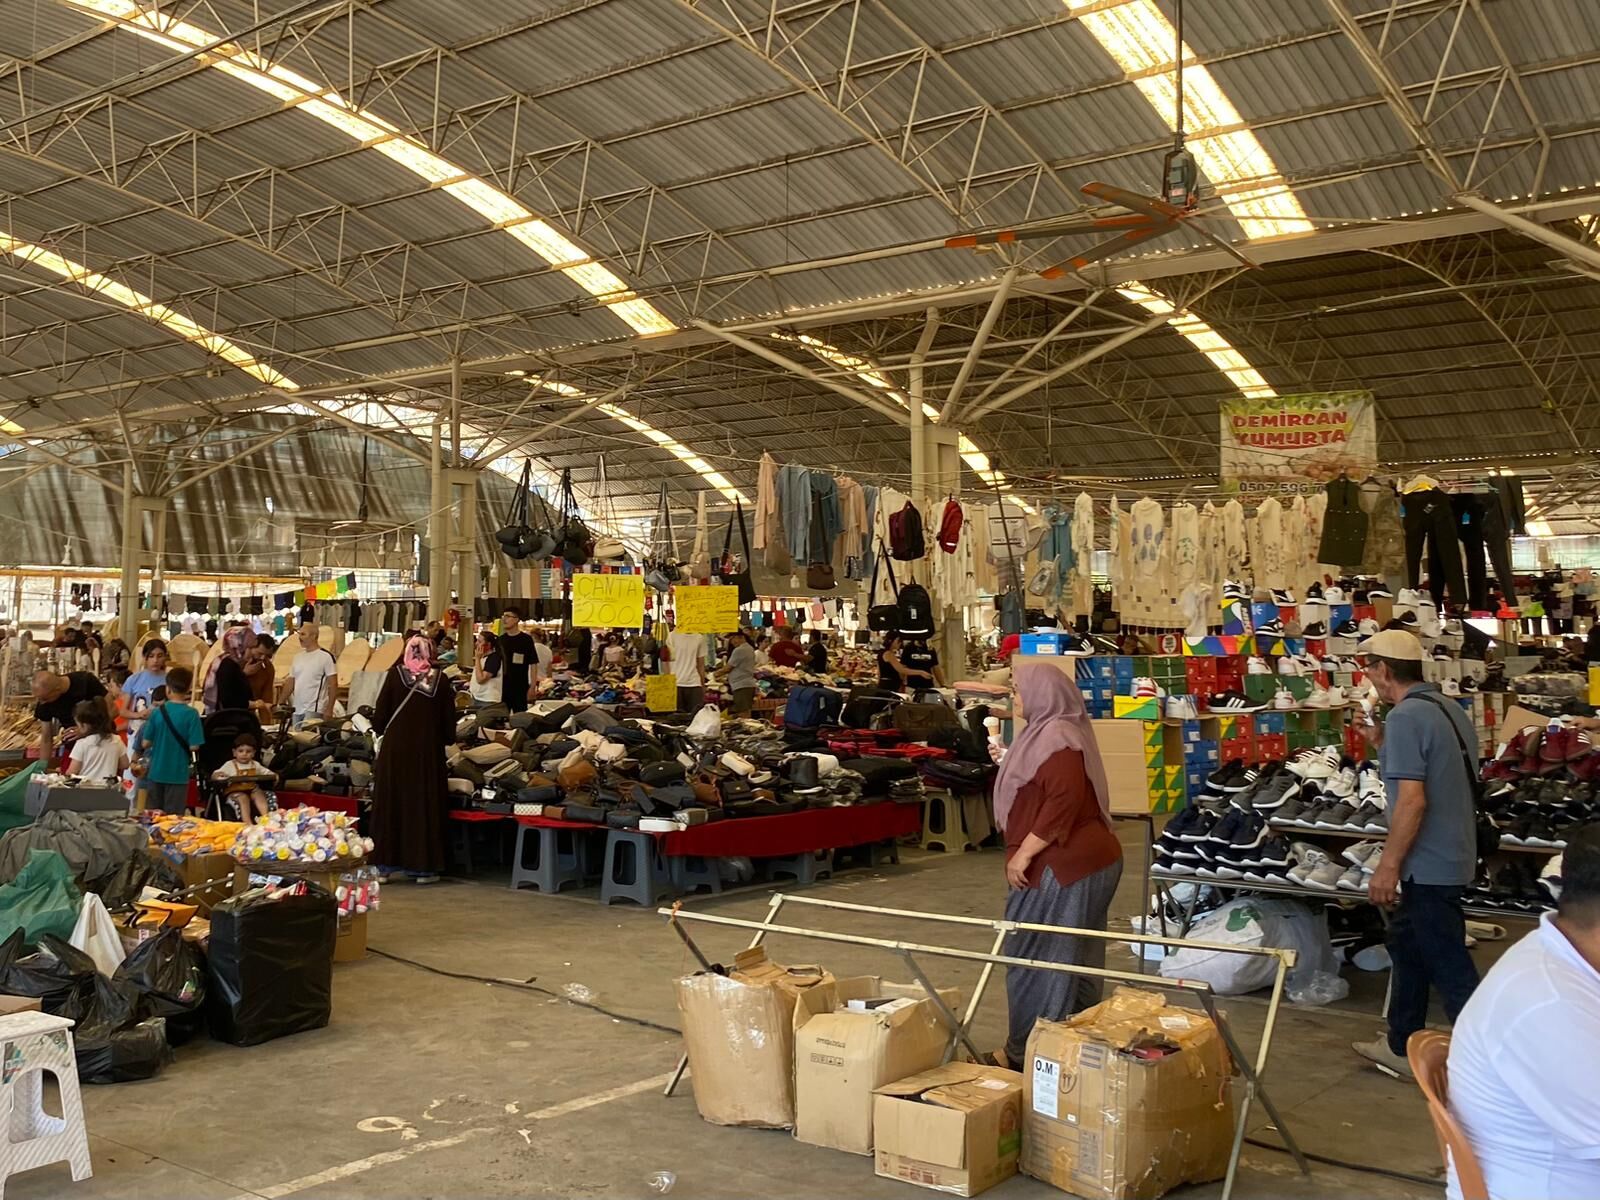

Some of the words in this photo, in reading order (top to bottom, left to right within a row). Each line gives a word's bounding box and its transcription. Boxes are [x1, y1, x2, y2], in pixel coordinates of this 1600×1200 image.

[1232, 410, 1348, 428] DEMİRCAN
[1234, 429, 1347, 446] YUMURTA
[581, 602, 634, 624] 200
